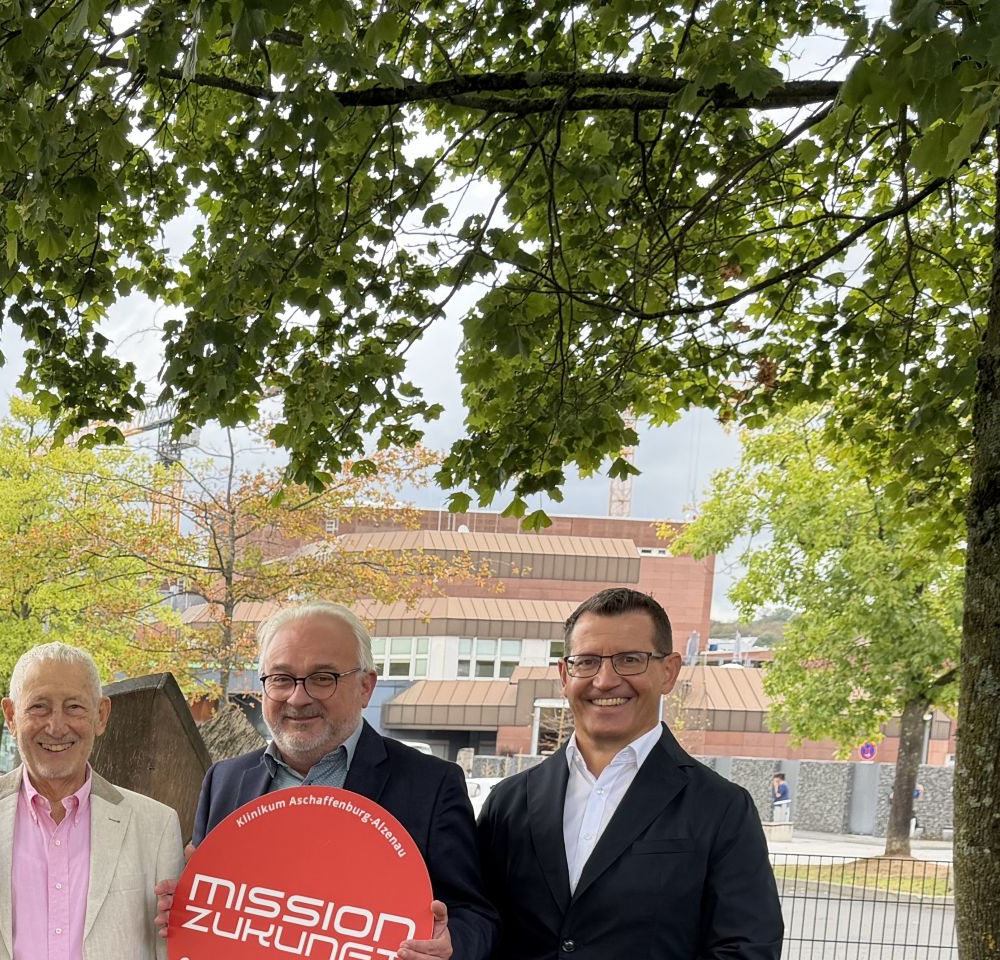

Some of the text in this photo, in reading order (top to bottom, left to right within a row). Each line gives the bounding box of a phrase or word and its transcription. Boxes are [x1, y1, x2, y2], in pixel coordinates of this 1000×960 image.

[236, 795, 407, 858] Klinikum Aschaffenburg-Alzenau
[188, 873, 417, 942] MISSION
